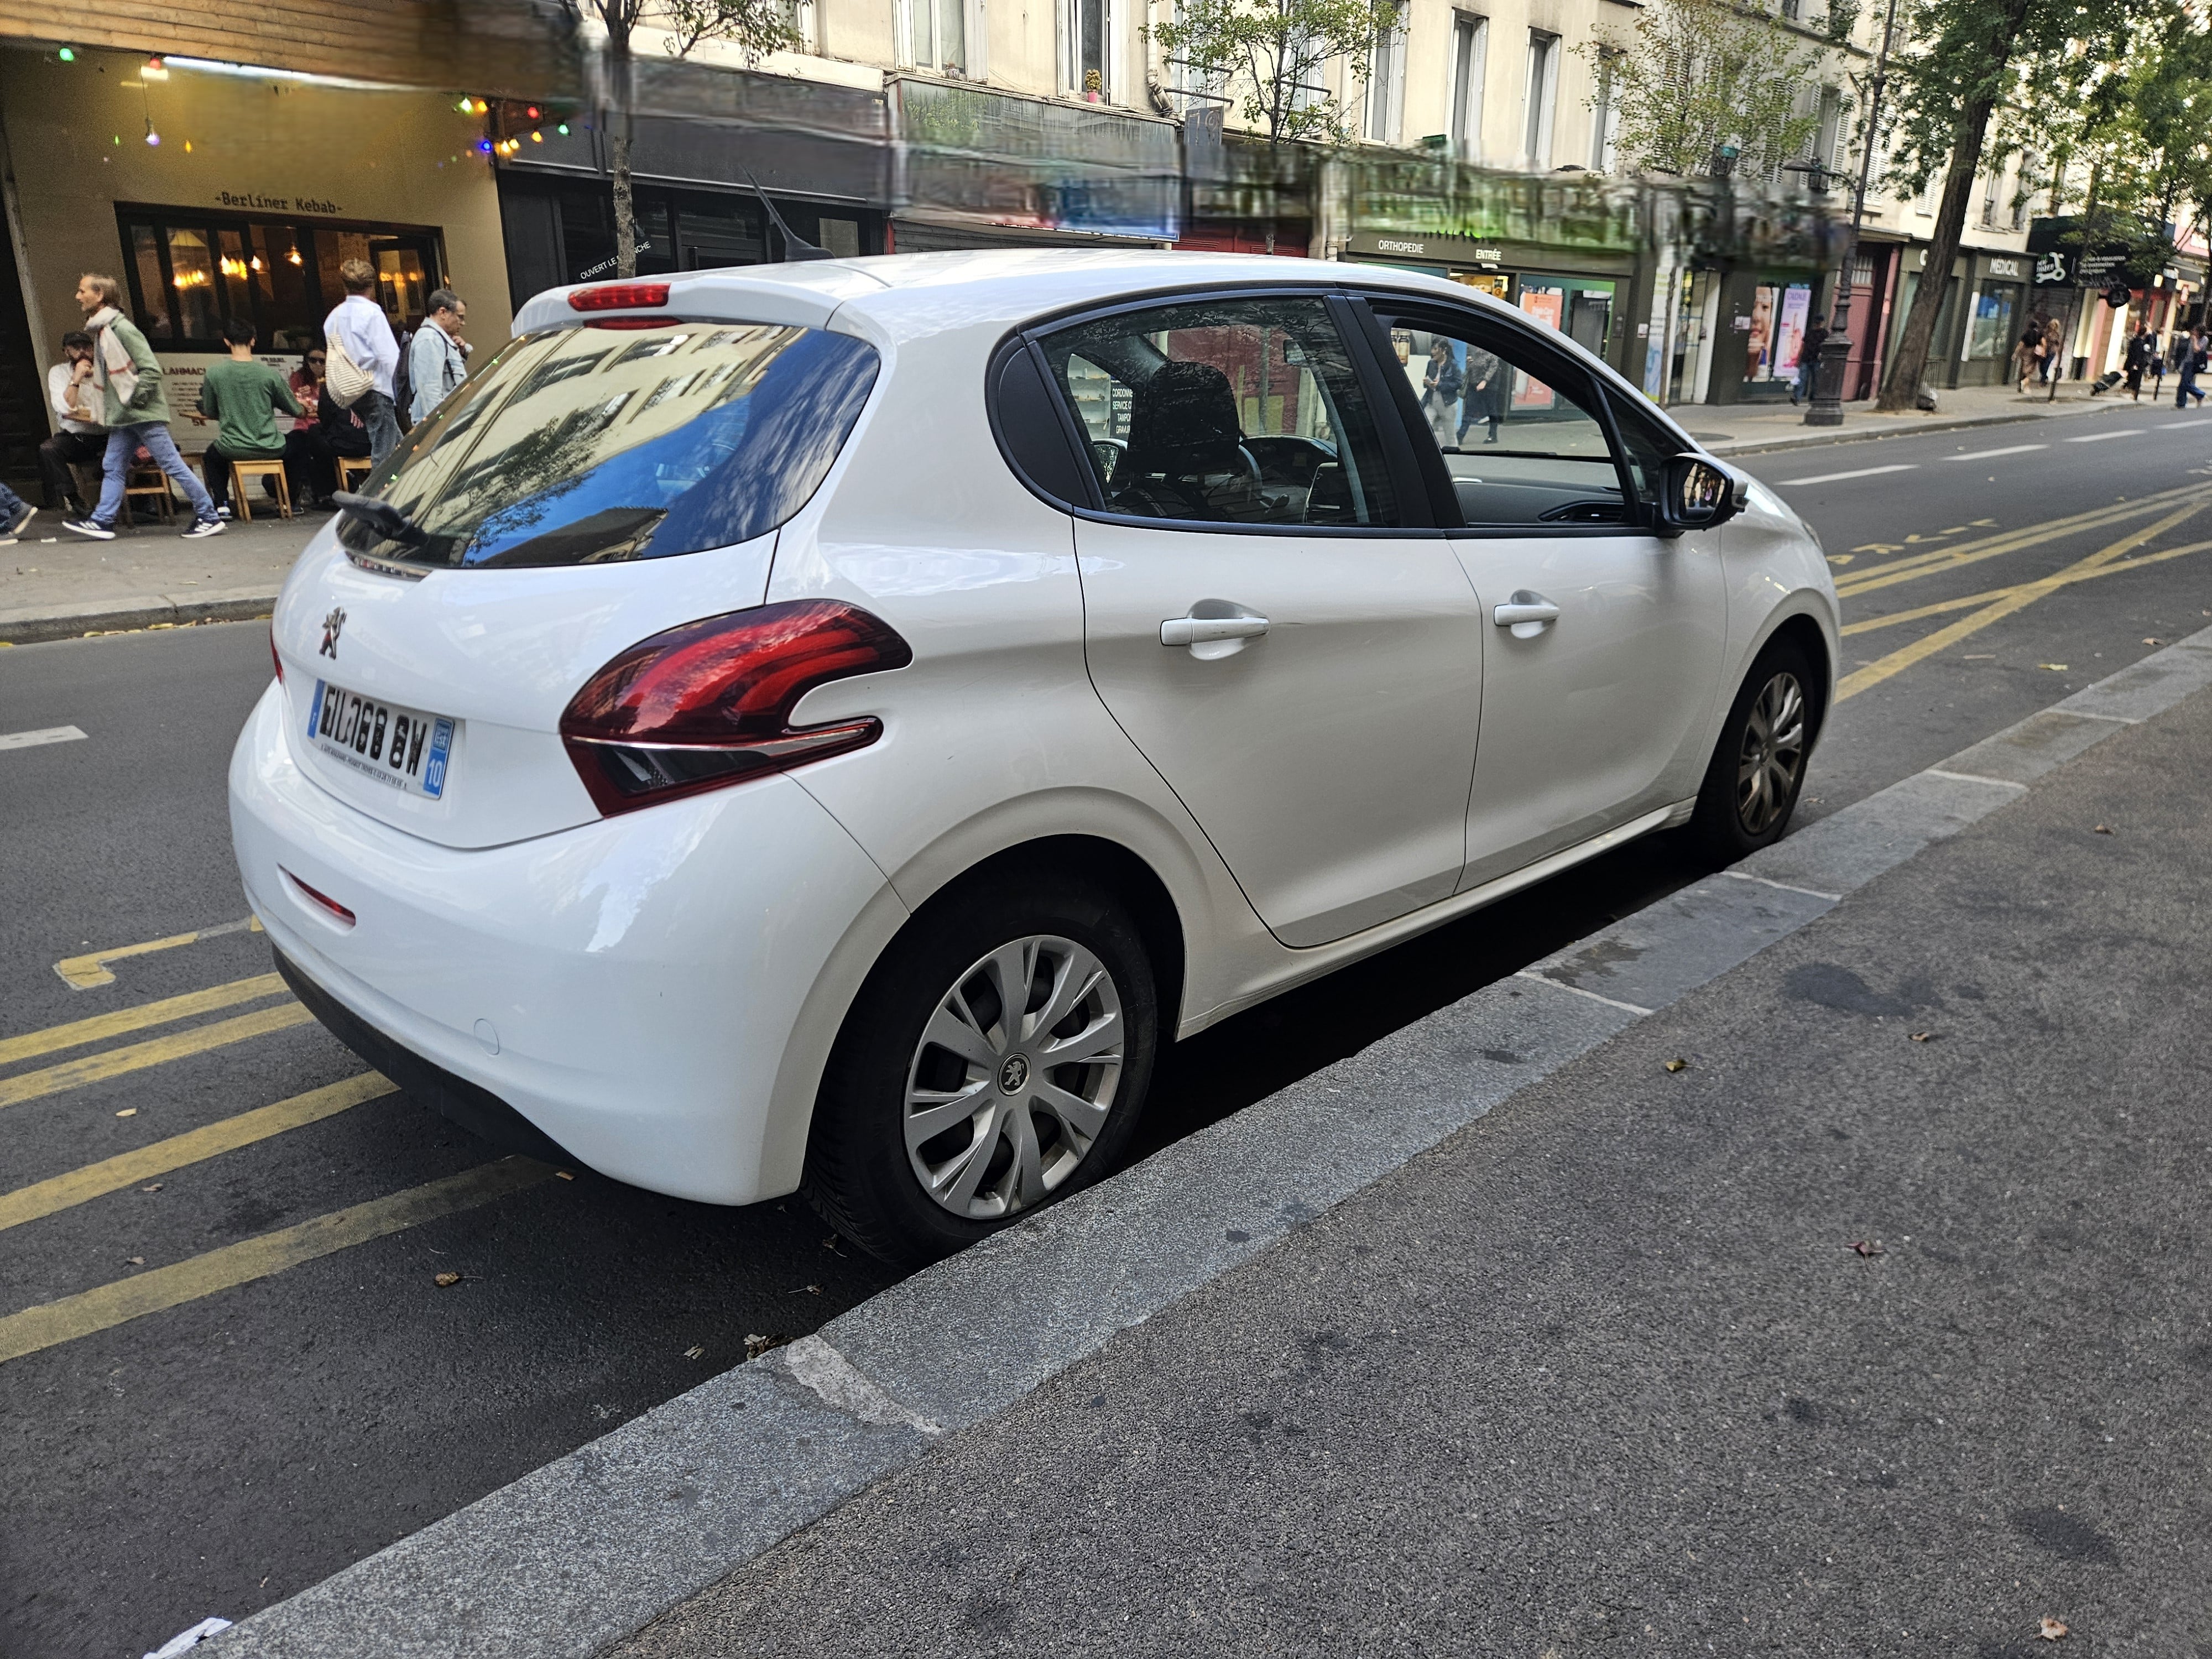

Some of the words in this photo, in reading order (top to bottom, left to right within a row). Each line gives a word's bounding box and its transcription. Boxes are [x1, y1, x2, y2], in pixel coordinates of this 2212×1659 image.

[1378, 239, 1424, 253] ORTHOPEDIE
[1475, 248, 1502, 261] ENTRÉE
[581, 262, 607, 279] OUVERT
[608, 257, 617, 267] LE
[1113, 401, 1128, 410] SERVICE
[427, 758, 442, 788] 10
